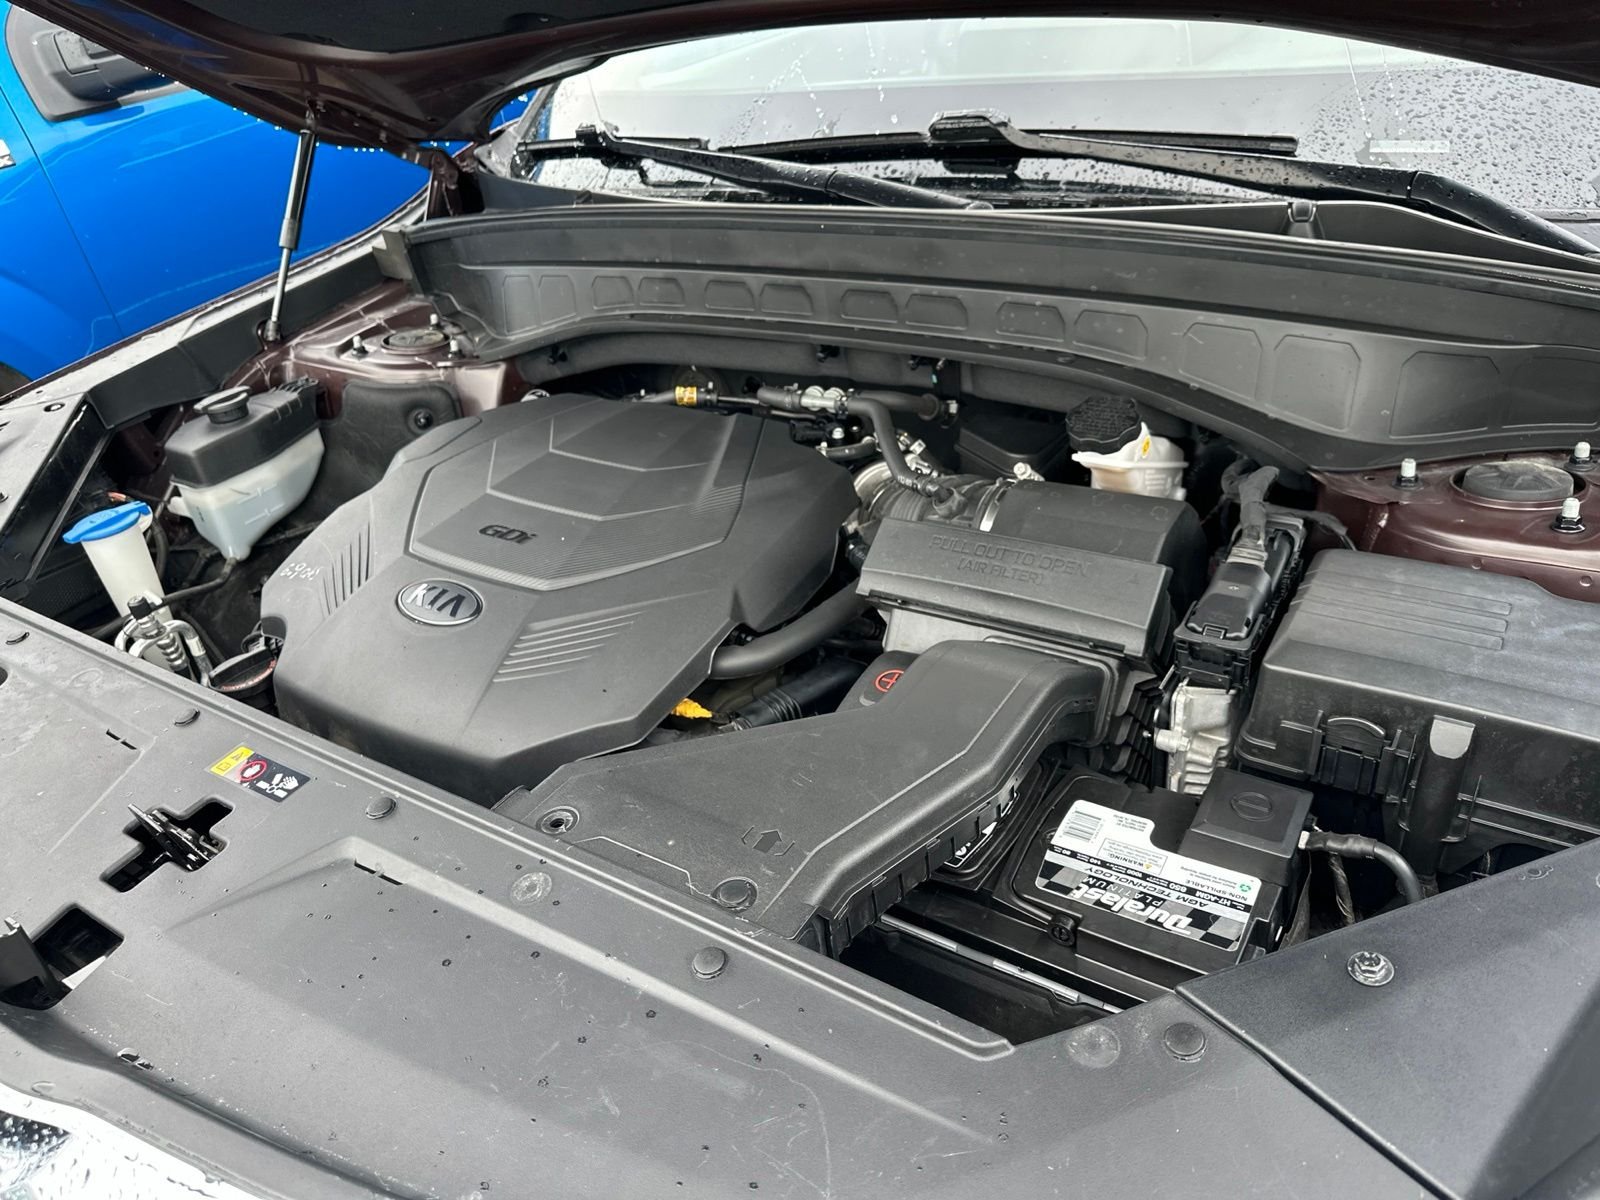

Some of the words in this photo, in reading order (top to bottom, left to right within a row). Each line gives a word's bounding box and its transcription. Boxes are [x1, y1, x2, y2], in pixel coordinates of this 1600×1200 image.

[929, 534, 969, 555] PULL
[974, 543, 1011, 562] OUT
[1011, 549, 1036, 567] TO
[1038, 554, 1092, 578] OPEN
[406, 583, 466, 617] KIA
[1107, 852, 1144, 869] WARNING:
[1085, 866, 1173, 895] TECHNOLOGY
[1127, 868, 1143, 879] 1000
[1083, 875, 1164, 907] PLATINUM
[1169, 881, 1187, 893] 850
[1185, 878, 1248, 902] NON-SPILLABLE
[1195, 890, 1231, 907] H7-AGM
[1071, 883, 1193, 936] Duralast
[1176, 892, 1211, 907] AGM
